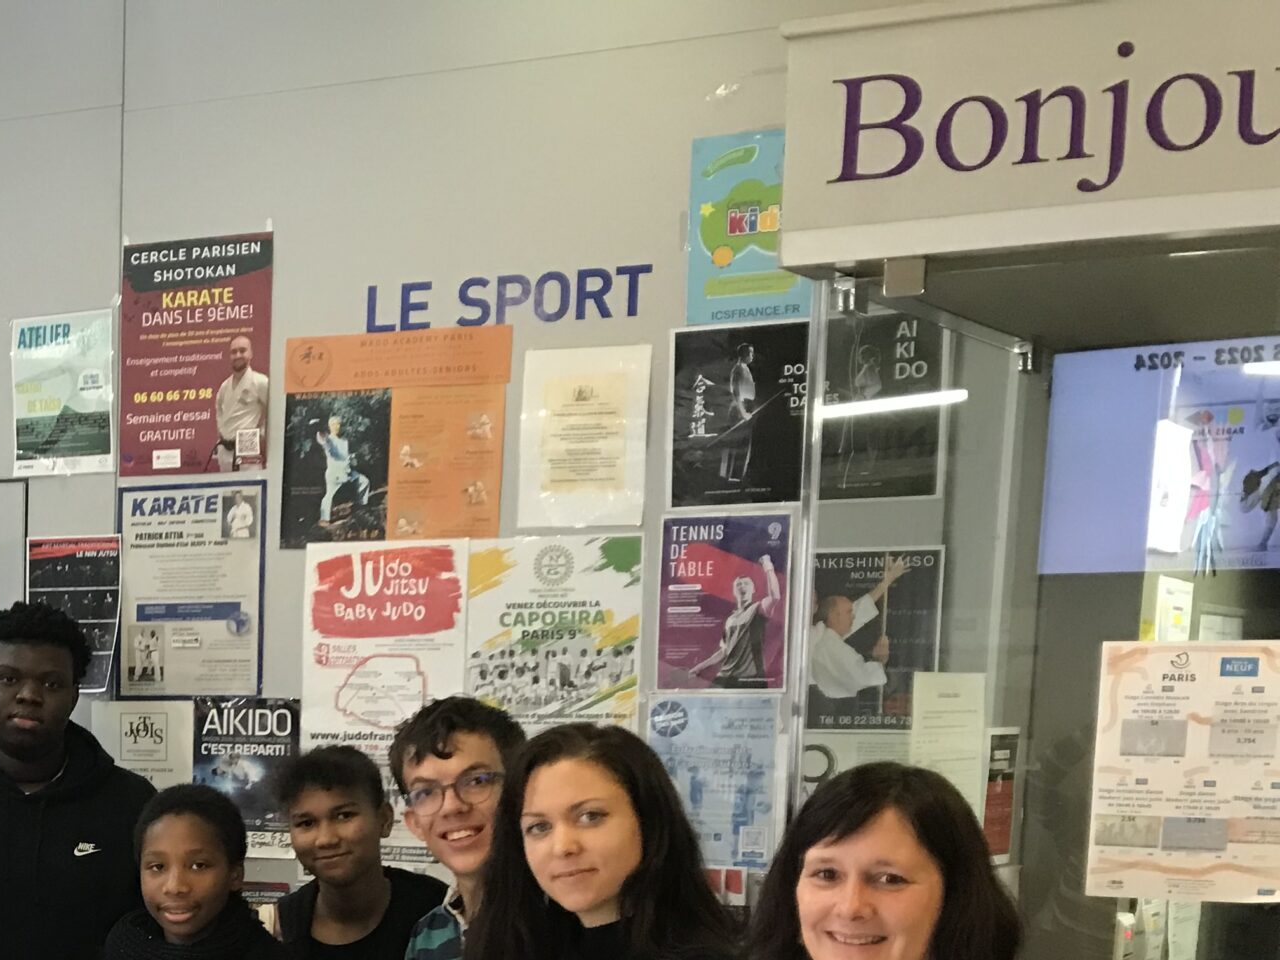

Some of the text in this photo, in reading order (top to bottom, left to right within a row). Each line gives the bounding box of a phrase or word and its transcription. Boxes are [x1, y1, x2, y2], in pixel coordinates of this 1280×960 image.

[727, 204, 782, 236] kid
[130, 242, 261, 265] CERCLE PARISIEN
[153, 264, 237, 283] SHOTOKAN
[162, 287, 235, 309] KARATE
[366, 263, 653, 334] LE SPORT
[142, 302, 254, 327] DANS LE 9ÈME!
[711, 303, 801, 320] ICSFRANCE.FR
[896, 321, 918, 338] AI
[896, 341, 915, 359] KI
[894, 361, 928, 380] DO
[133, 391, 148, 404] 06
[149, 390, 164, 403] 60
[182, 388, 196, 401] 70
[197, 387, 213, 400] 98
[126, 408, 211, 425] Semaine d'essai
[139, 428, 195, 442] GRATUITE!
[130, 494, 219, 517] KARATE
[671, 524, 724, 541] TENNIS
[670, 544, 688, 560] DE
[670, 561, 714, 577] TABLE
[381, 601, 426, 621] JUDO
[536, 600, 588, 609] DÉCOUVRIR
[499, 609, 606, 628] CAPOEIRA
[521, 629, 565, 640] PARIS
[1162, 663, 1255, 682] PARIS NEUF
[201, 743, 233, 755] C'EST
[78, 841, 96, 851] NIKE
